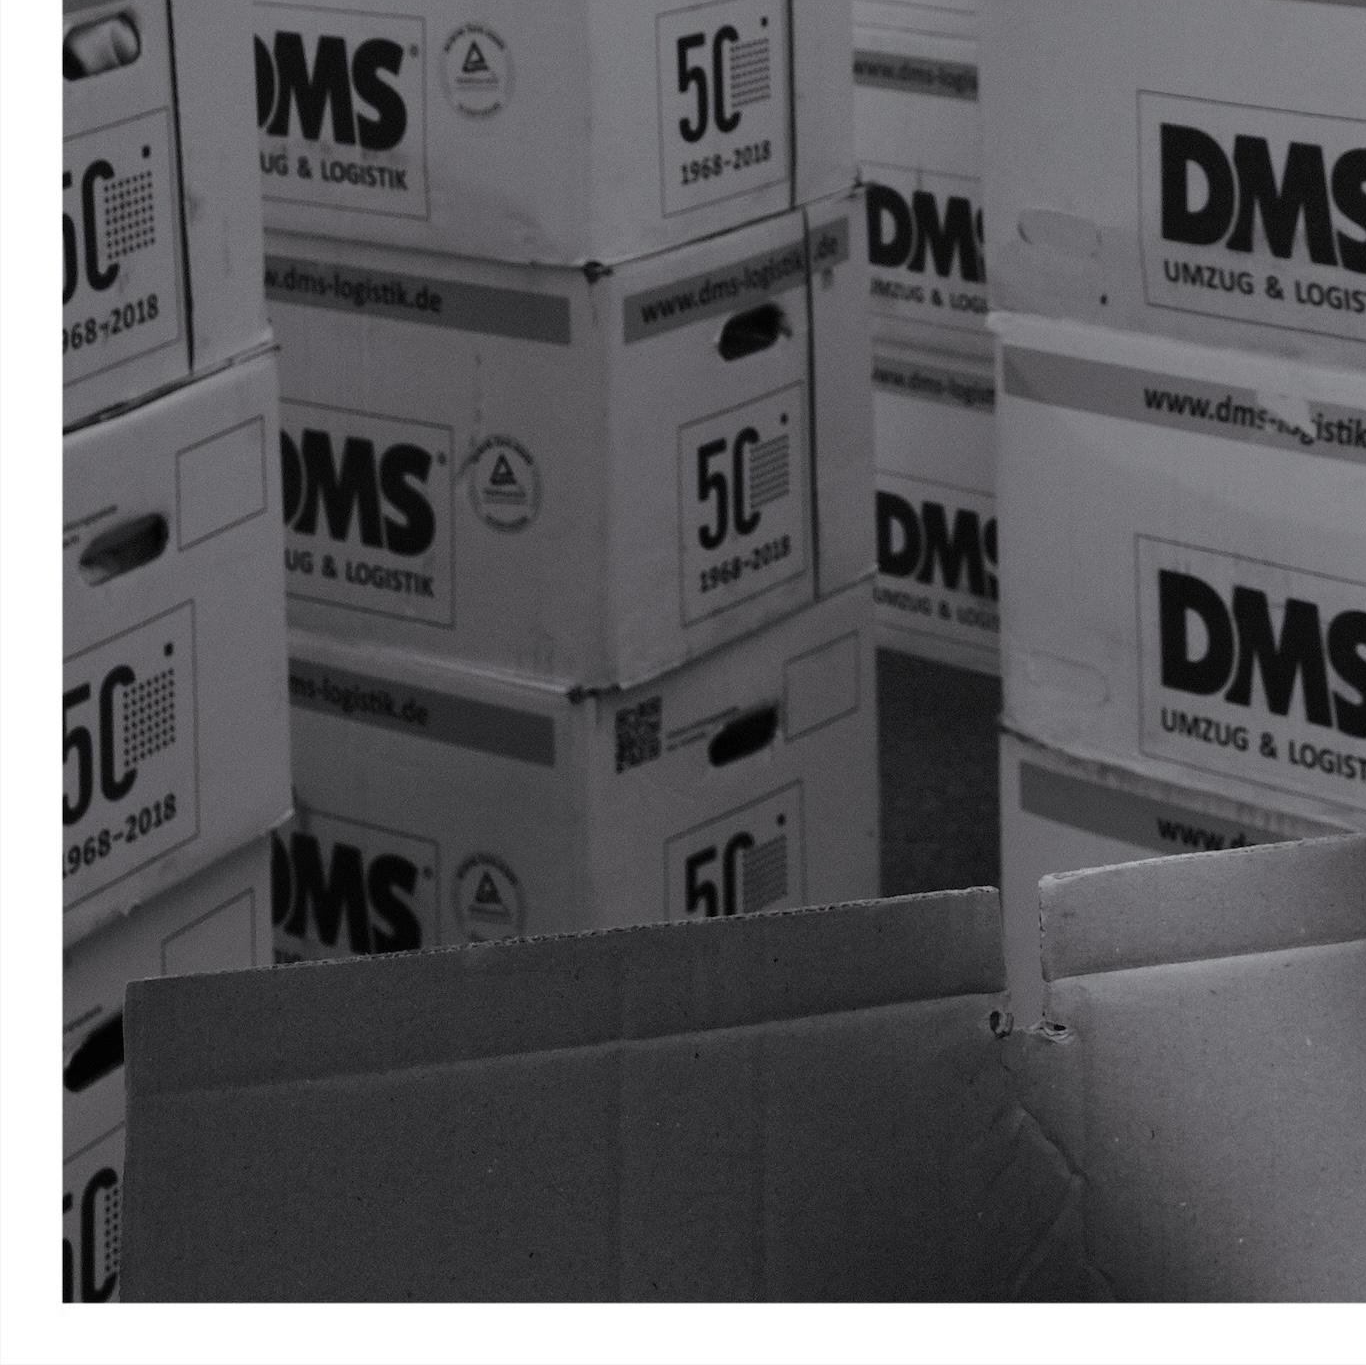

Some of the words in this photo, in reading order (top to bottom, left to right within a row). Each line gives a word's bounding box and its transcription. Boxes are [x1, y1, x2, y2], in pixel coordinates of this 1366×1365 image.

[298, 158, 312, 179] &
[322, 161, 407, 190] LOGISTIK
[680, 139, 772, 187] 1968-2018
[865, 182, 986, 284] DM
[1162, 258, 1254, 298] UMZUG
[1265, 271, 1285, 300] &
[321, 552, 338, 579] &
[346, 556, 434, 599] LOGISTIK
[699, 535, 790, 594] 1968-2018
[1161, 707, 1250, 753] UMZUG
[1260, 728, 1278, 758] &
